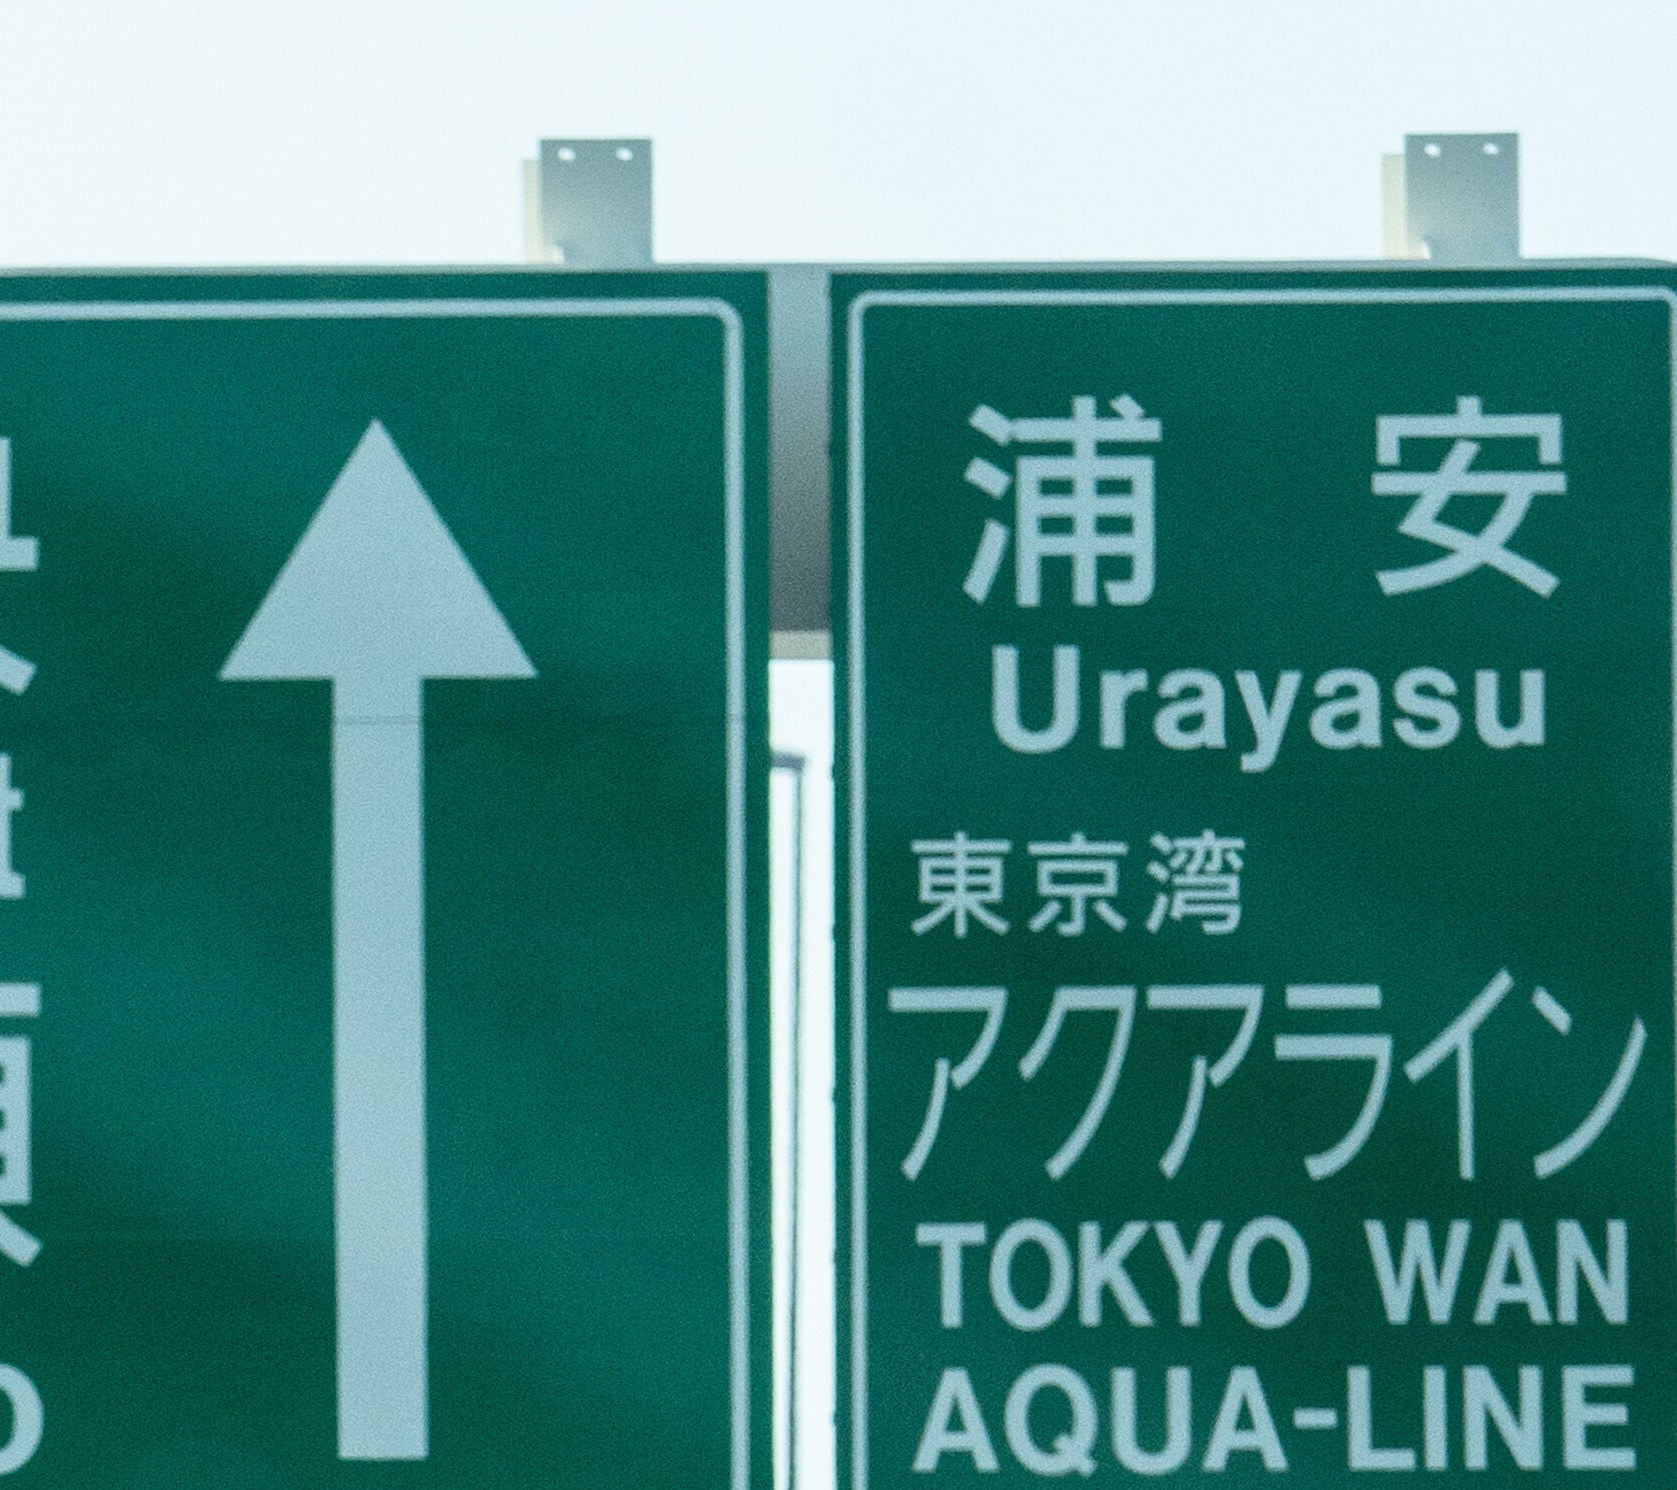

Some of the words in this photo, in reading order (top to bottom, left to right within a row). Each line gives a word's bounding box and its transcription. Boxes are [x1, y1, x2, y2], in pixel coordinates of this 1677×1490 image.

[964, 395, 1566, 607] 浦安
[993, 646, 1544, 772] Urayasu
[911, 830, 1245, 937] 東京湾
[888, 970, 1646, 1180] アクアライン
[916, 1217, 1310, 1331] TOKYO
[1364, 1220, 1627, 1324] WAN
[913, 1364, 1635, 1476] AQUA-LINE
